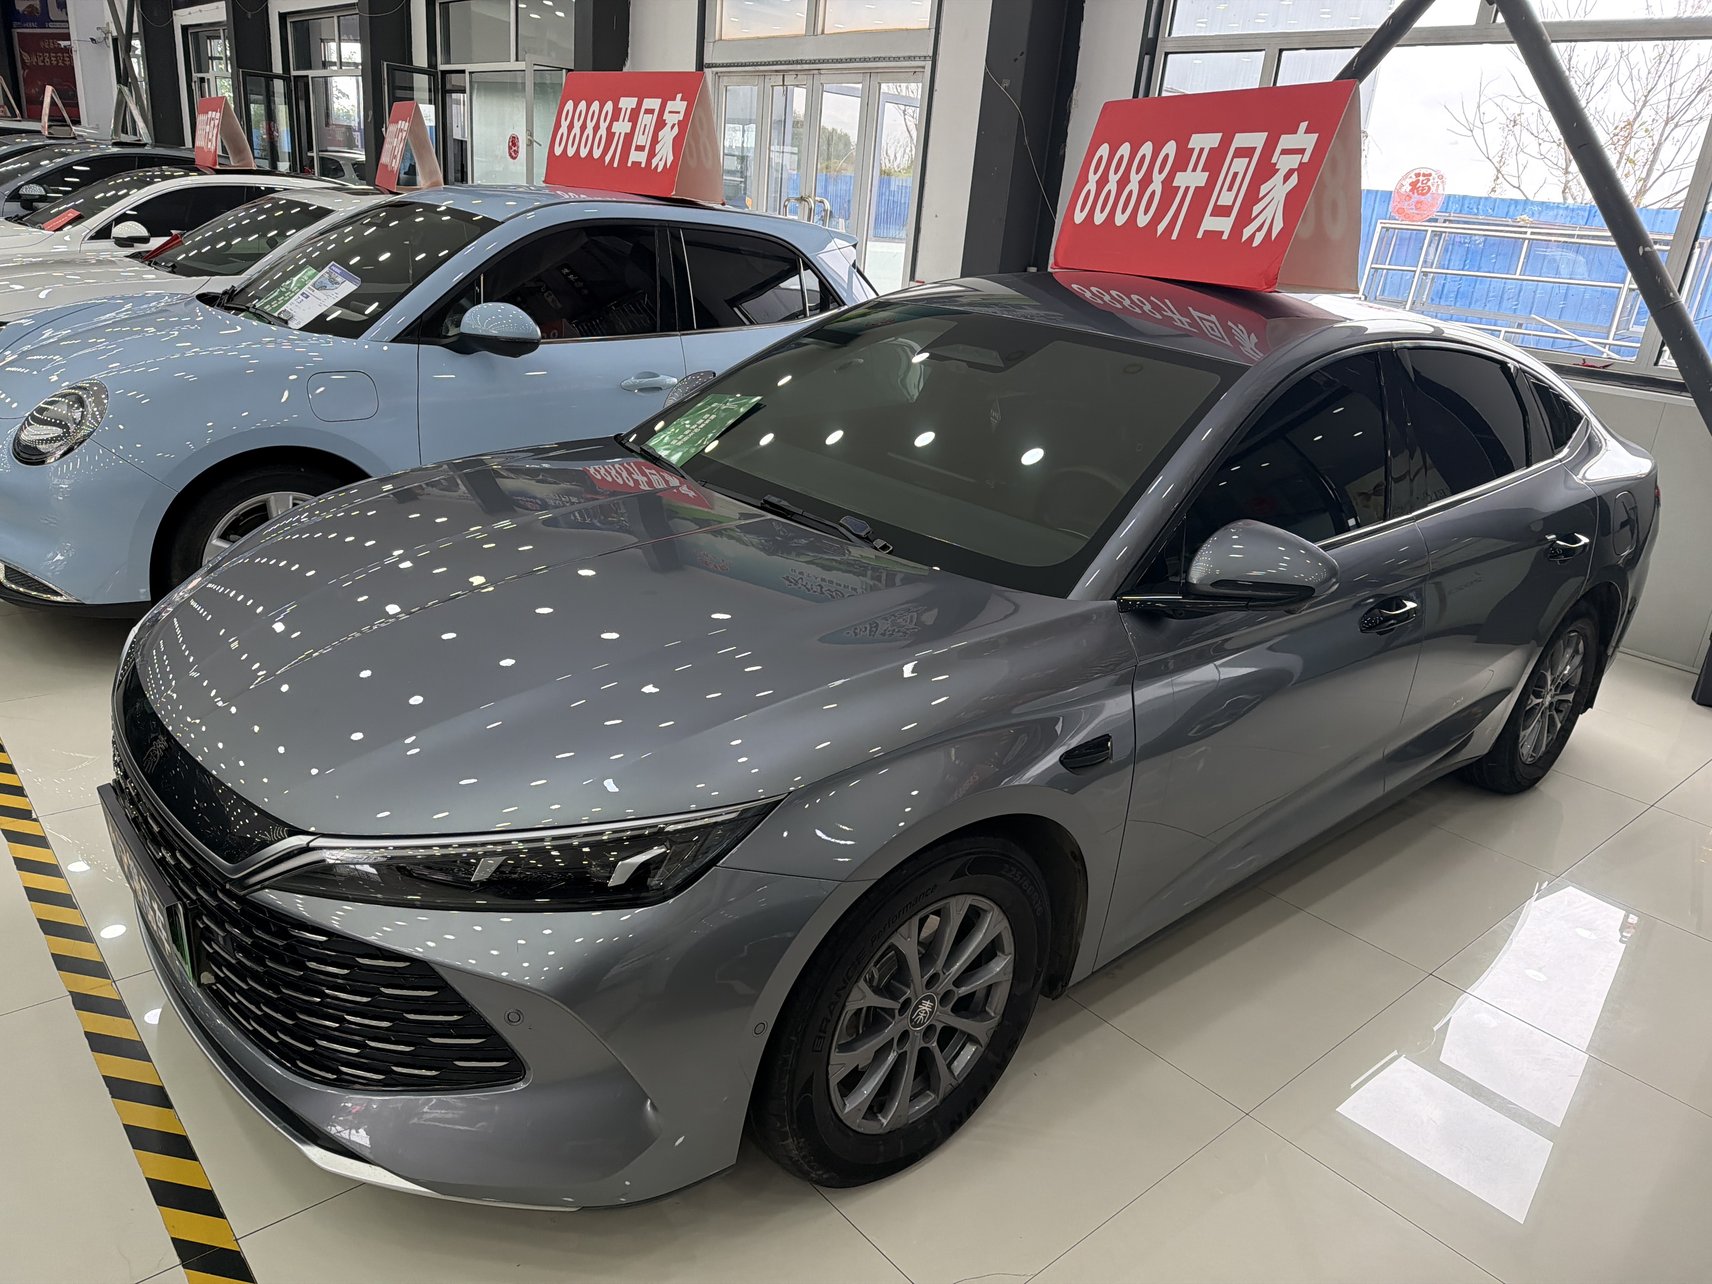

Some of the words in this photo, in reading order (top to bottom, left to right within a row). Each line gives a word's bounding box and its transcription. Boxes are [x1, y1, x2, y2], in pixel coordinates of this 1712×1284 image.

[553, 93, 689, 173] 8888开回家
[1073, 120, 1320, 248] 8888开回家
[1408, 172, 1433, 197] 福
